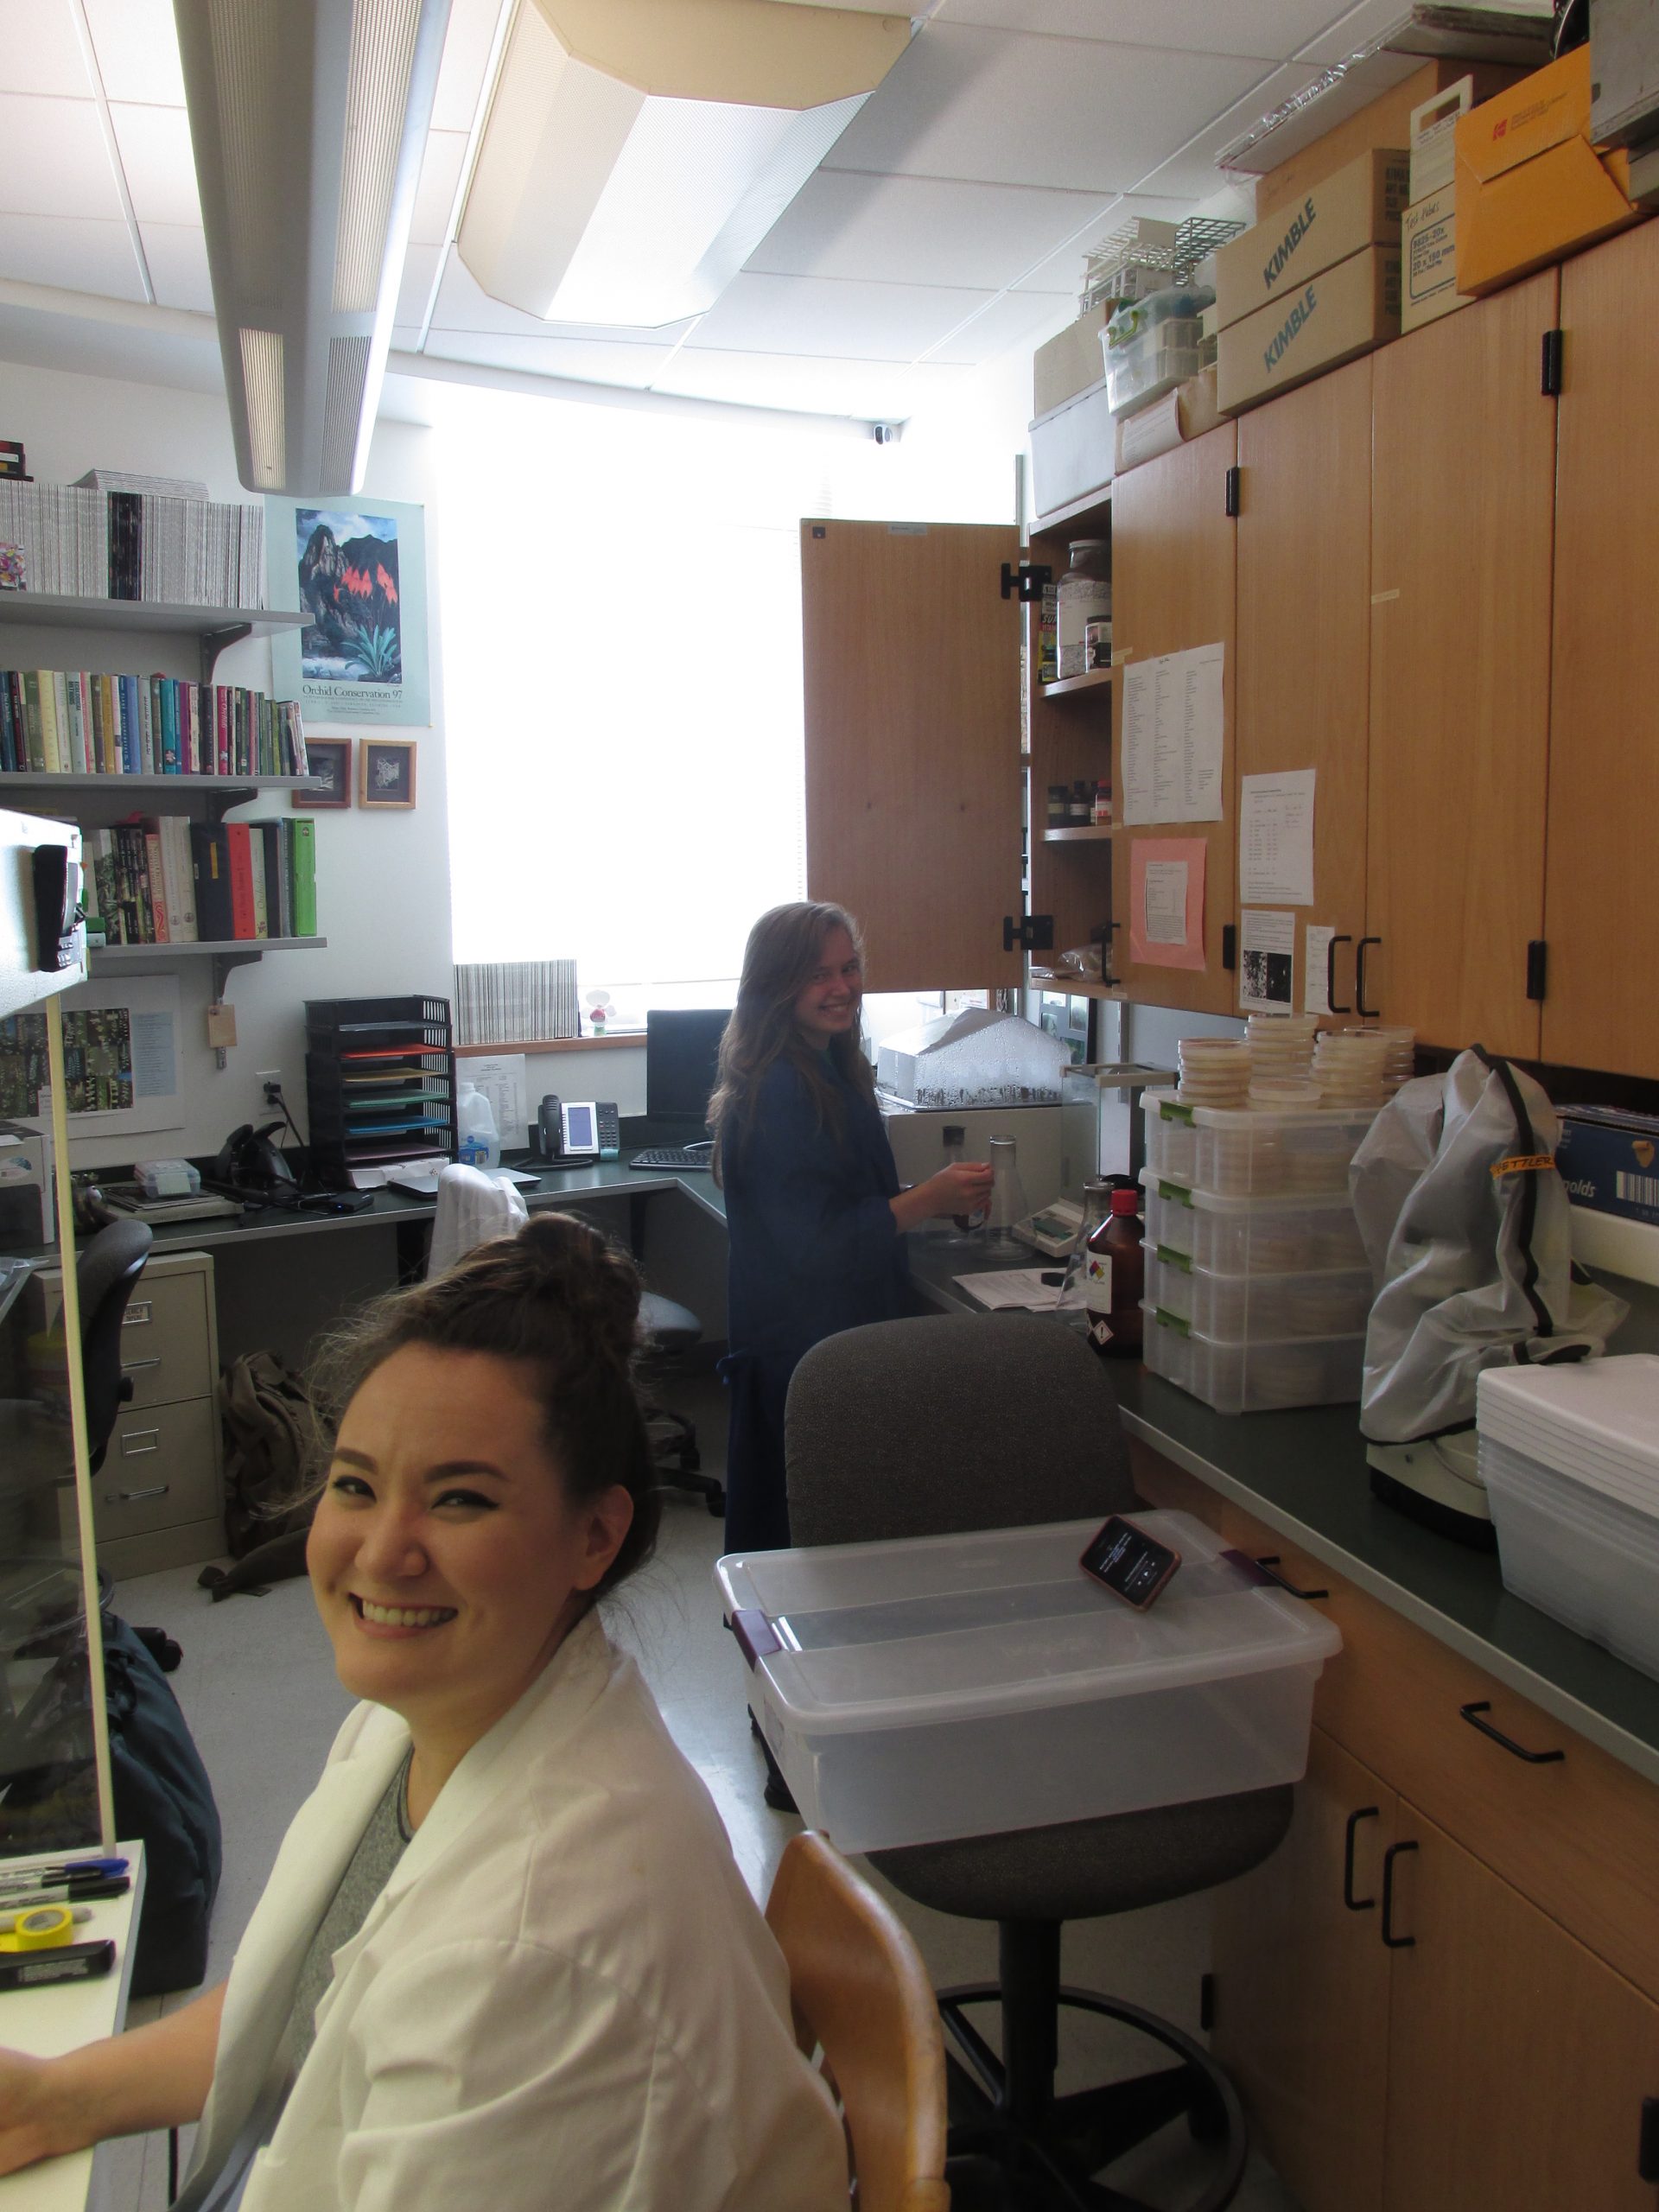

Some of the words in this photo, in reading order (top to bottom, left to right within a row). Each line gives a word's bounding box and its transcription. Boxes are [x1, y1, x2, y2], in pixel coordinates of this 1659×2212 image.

[1263, 197, 1317, 290] KIMBLE
[1263, 283, 1318, 373] KIMBLE
[302, 684, 332, 696] Orchid
[334, 686, 391, 699] Conservation
[392, 690, 403, 699] 97
